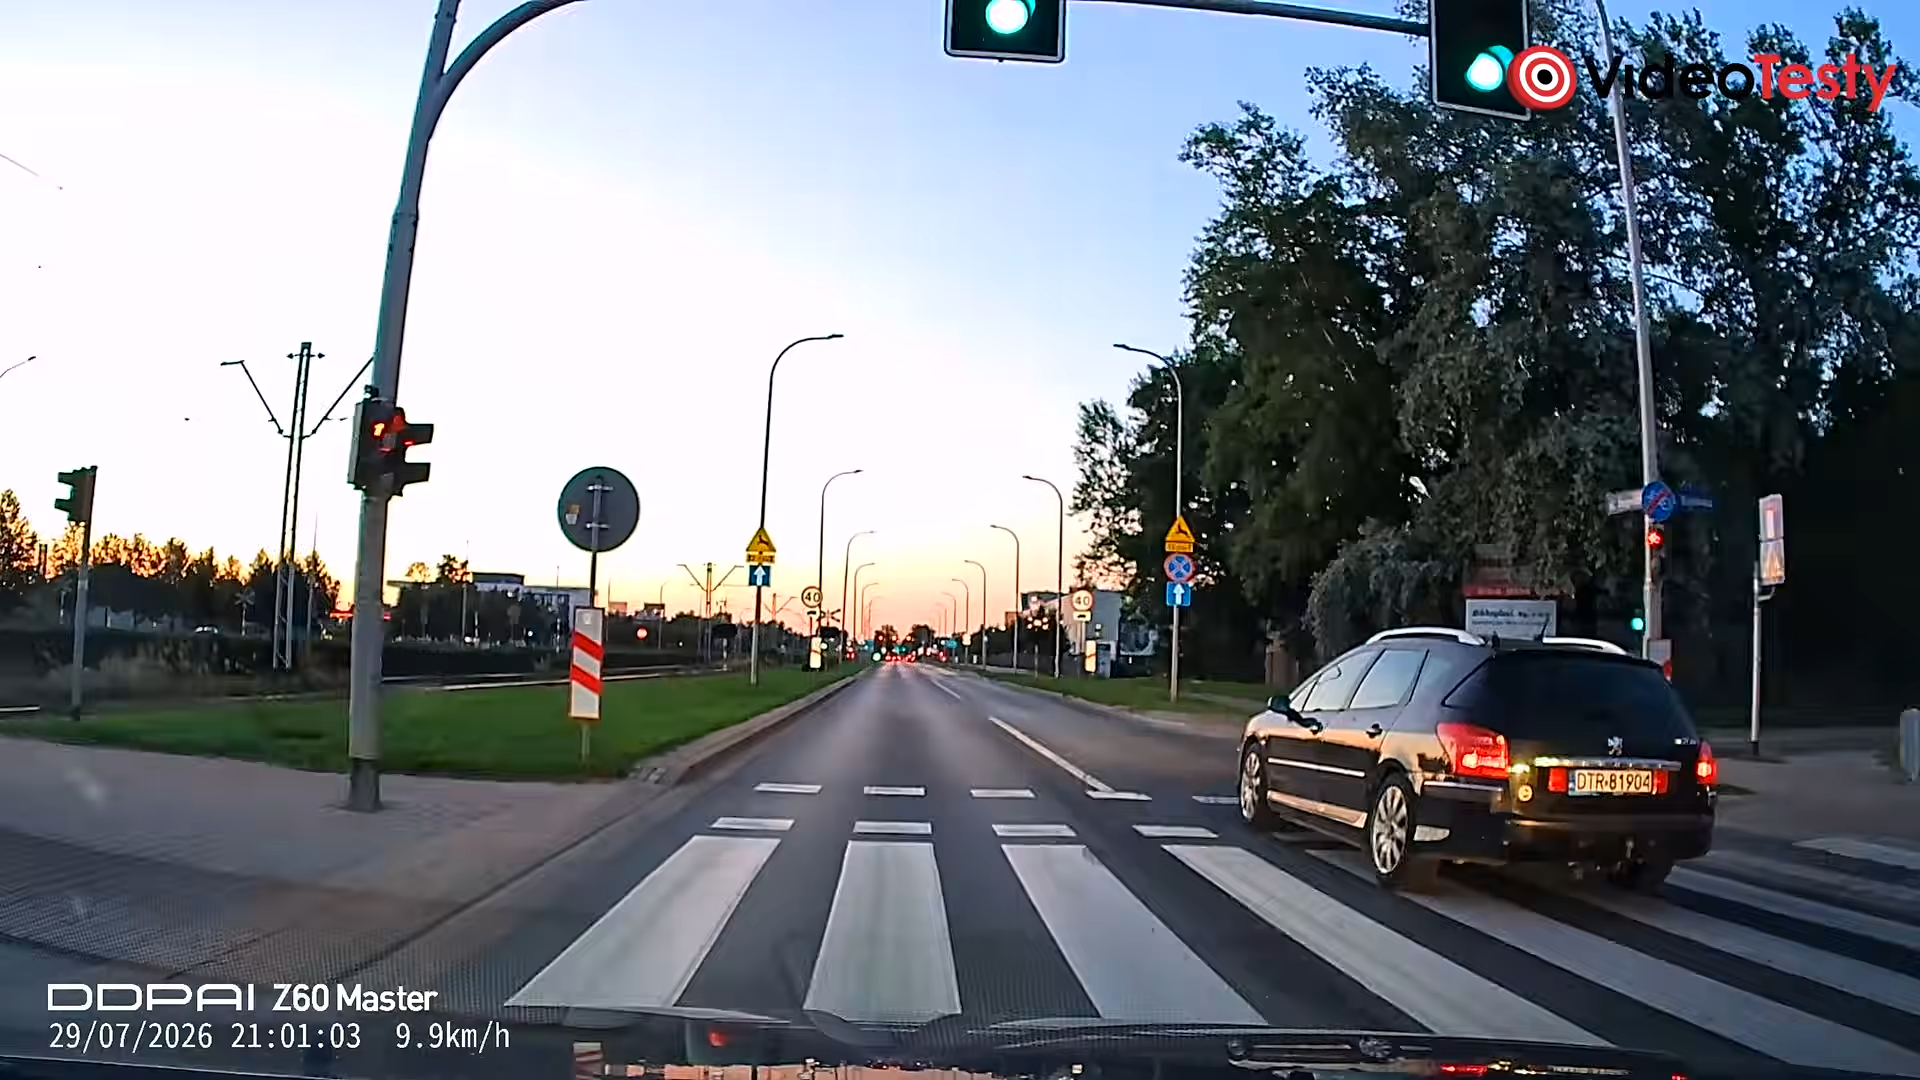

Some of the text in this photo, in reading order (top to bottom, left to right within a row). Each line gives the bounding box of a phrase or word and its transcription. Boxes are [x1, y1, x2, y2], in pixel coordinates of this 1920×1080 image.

[805, 592, 821, 602] 40
[1075, 596, 1090, 606] 40
[1577, 773, 1651, 791] DTR 81904
